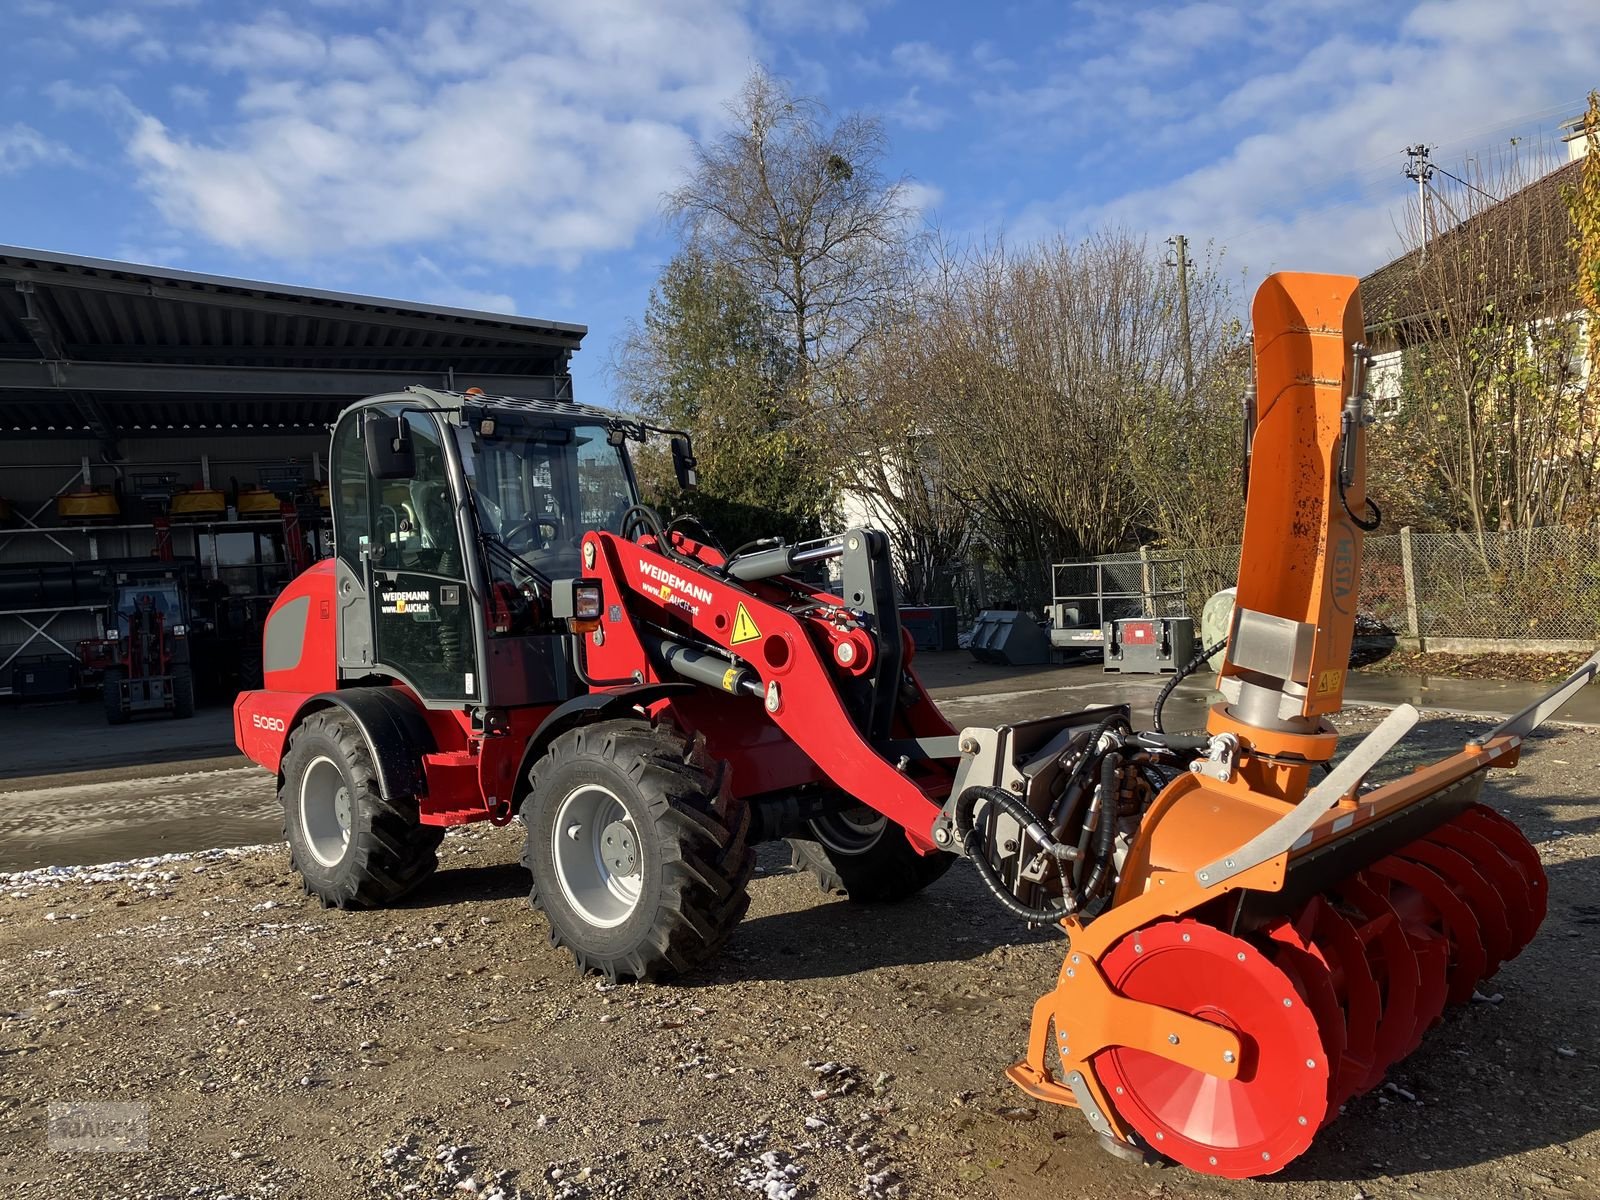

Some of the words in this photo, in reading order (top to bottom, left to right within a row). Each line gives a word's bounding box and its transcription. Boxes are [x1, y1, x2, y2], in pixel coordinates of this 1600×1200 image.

[639, 559, 713, 605] WEIDEMANN
[382, 591, 430, 601] WEIDEMANN
[252, 714, 285, 732] 5080
